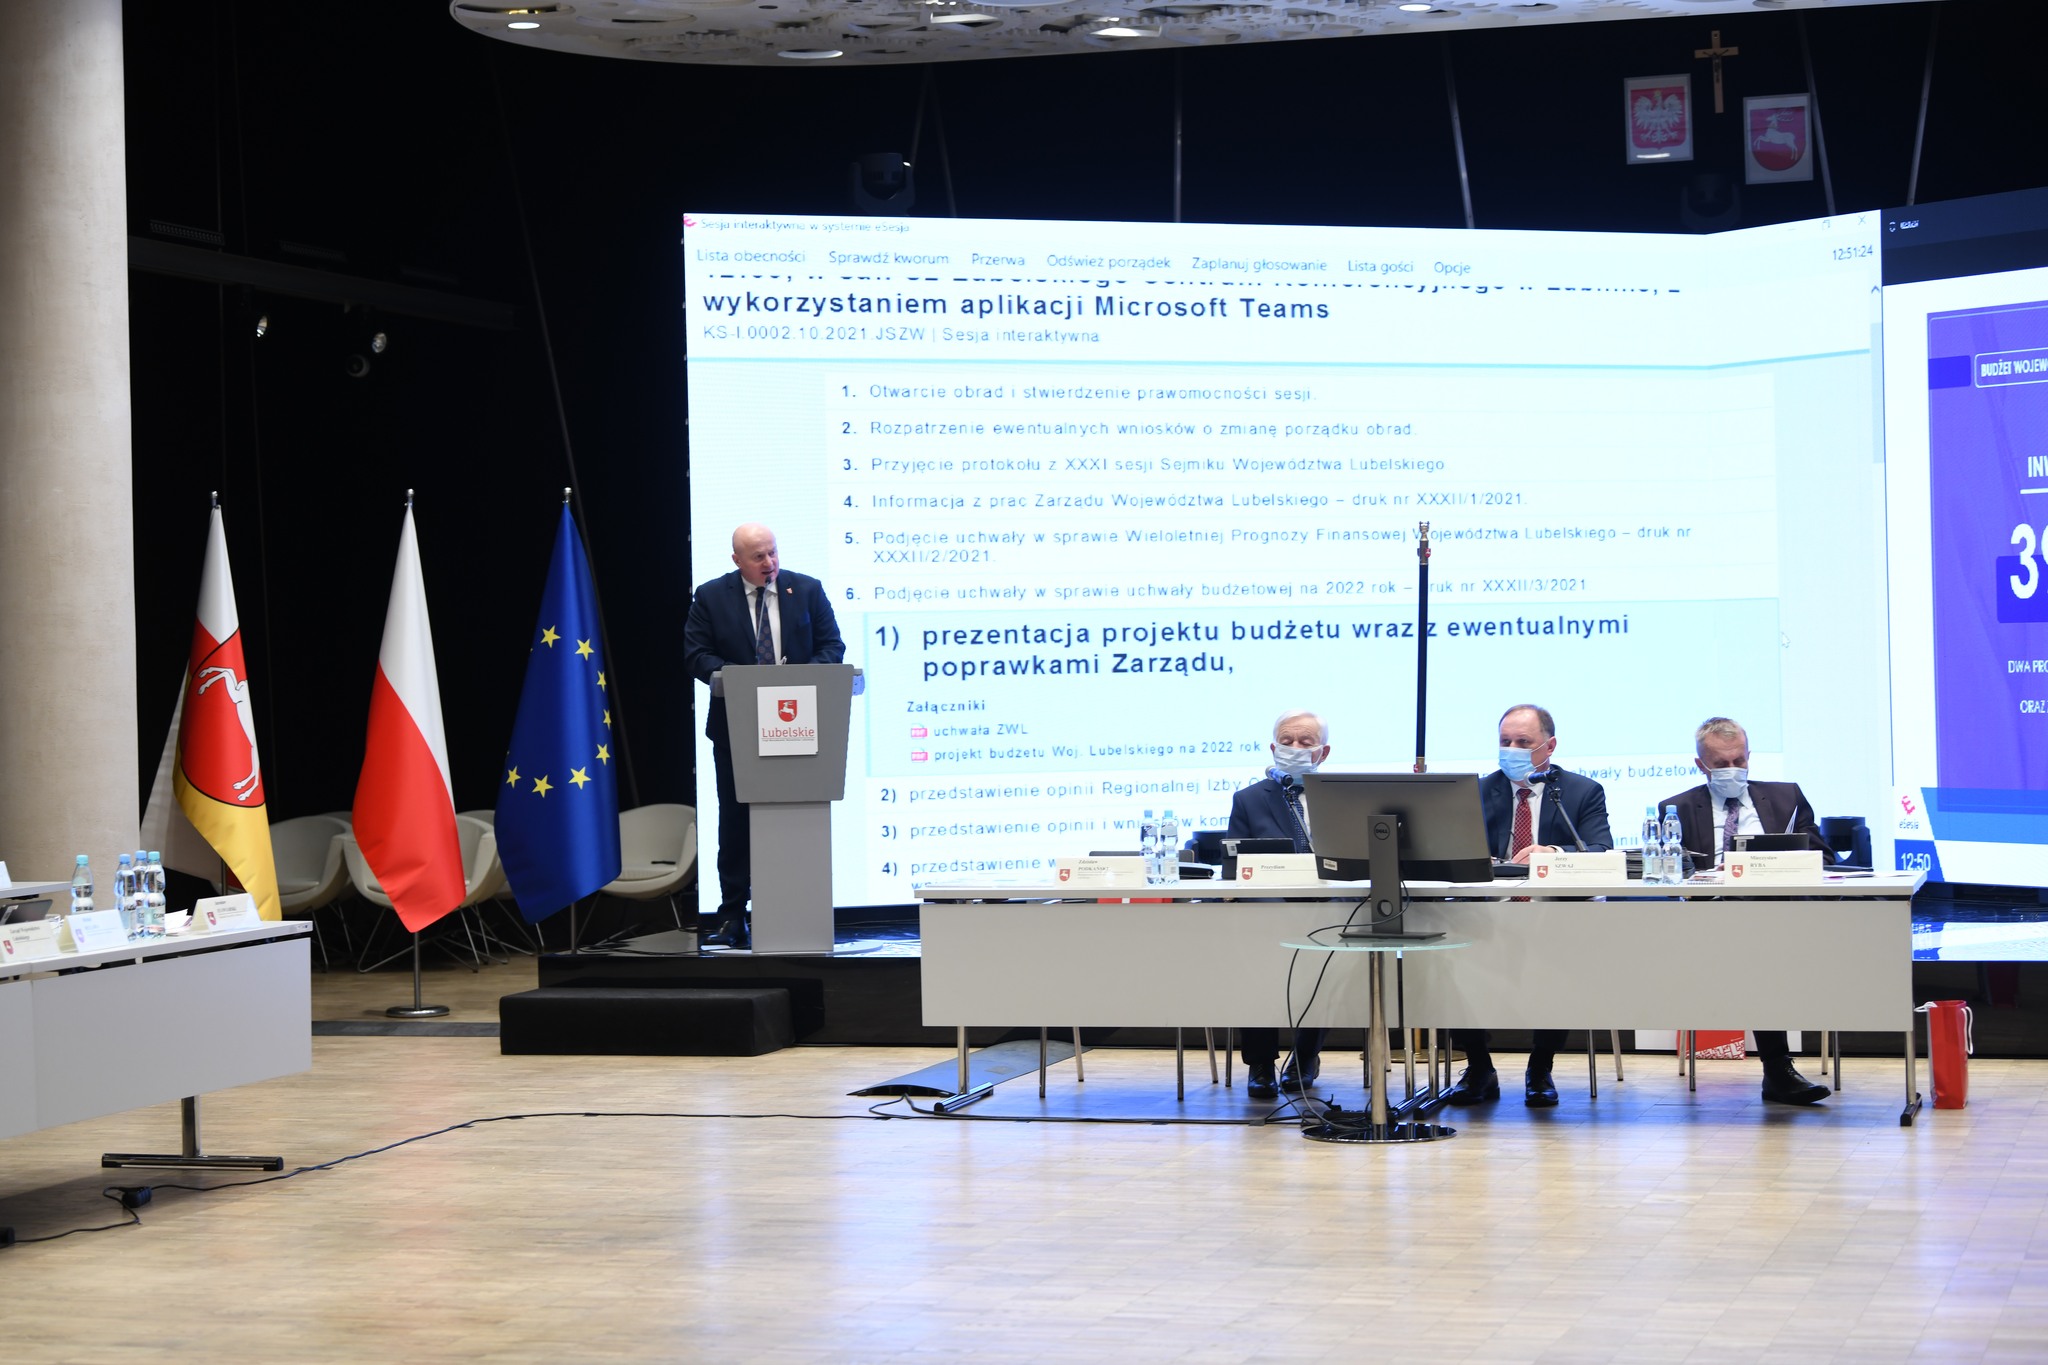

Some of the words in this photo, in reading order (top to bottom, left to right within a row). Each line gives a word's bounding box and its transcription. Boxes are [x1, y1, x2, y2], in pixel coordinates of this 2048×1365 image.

[701, 219, 730, 231] Sesja
[734, 219, 805, 232] interaktywna
[822, 222, 872, 233] systemie
[697, 249, 730, 262] Lista
[734, 250, 805, 263] obecności
[829, 251, 890, 266] Sprawdź
[894, 252, 950, 264] kworum
[972, 253, 1025, 266] Przerwa
[1833, 245, 1874, 260] 12:51:24
[1109, 257, 1171, 270] porządek
[1192, 257, 1249, 272] Zaplanuj
[1253, 259, 1328, 273] głosowanie
[1348, 260, 1377, 272] Lista
[1380, 261, 1413, 275] gości
[1434, 261, 1472, 276] Opcje
[703, 291, 946, 317] wykorzystaniem
[961, 295, 1082, 320] aplikacji
[1096, 296, 1227, 317] Microsoft
[1239, 298, 1329, 318] Teams
[943, 328, 990, 343] Sesja
[997, 329, 1101, 344] interaktywna
[1981, 359, 2012, 377] BUDŻET
[842, 385, 856, 397] 1.
[870, 384, 946, 398] Otwarcie
[954, 385, 1004, 398] obrad
[1023, 386, 1131, 399] stwierdzenie
[1138, 386, 1267, 401] prawomocności
[842, 422, 856, 434] 2.
[871, 422, 984, 436] Rozpatrzenie
[993, 422, 1109, 437] ewentualnych
[1117, 422, 1196, 435] wniosków
[1203, 425, 1213, 435] o
[1220, 425, 1277, 438] zmianę
[1285, 423, 1359, 438] porządku
[843, 458, 857, 470] 3.
[872, 458, 954, 474] Przyjęcie
[962, 458, 1040, 472] protokołu
[1048, 460, 1057, 470] z
[1065, 458, 1107, 470] XXXI
[1115, 460, 1153, 474] sesji
[1161, 458, 1225, 473] Sejmiku
[1233, 458, 1343, 473] Województwa
[1350, 458, 1445, 473] Lubelskiego
[843, 495, 858, 507] 4.
[873, 495, 964, 509] Informacja
[972, 497, 981, 507] z
[990, 497, 1027, 509] prac
[1035, 494, 1104, 508] Zarządu
[1111, 494, 1224, 508] Województwa
[1232, 494, 1328, 508] Lubelskiego
[1353, 494, 1387, 505] druk
[1394, 496, 1410, 505] nr
[845, 532, 859, 544] 5.
[873, 532, 948, 547] Podjęcie
[956, 531, 1025, 546] uchwały
[1034, 533, 1045, 542] w
[1053, 532, 1119, 546] sprawie
[1125, 530, 1224, 544] Wieloletniej
[1232, 529, 1309, 544] Prognozy
[1317, 528, 1406, 543] Finansowej
[1525, 527, 1616, 541] Lubelskiego
[1637, 527, 1670, 538] druk
[1677, 528, 1691, 537] nr
[846, 588, 860, 600] 6.
[875, 587, 950, 602] Podjęcie
[957, 585, 1026, 601] uchwały
[1035, 588, 1046, 597] w
[1055, 587, 1120, 600] sprawie
[1127, 584, 1193, 599] uchwały
[1202, 583, 1292, 597] budżetowej
[1300, 584, 1318, 594] na
[1326, 581, 1364, 594] 2022
[1372, 581, 1396, 593] rok
[1430, 581, 1452, 592] ruk
[1461, 583, 1475, 592] nr
[876, 626, 899, 651] 1)
[923, 623, 1090, 650] prezentacja
[1103, 622, 1219, 647] projektu
[1232, 620, 1340, 640] budżetu
[1352, 623, 1414, 638] wraz
[1426, 622, 1438, 638] z
[1448, 614, 1628, 639] ewentualnymi
[924, 654, 1098, 682] poprawkami
[1112, 652, 1233, 676] Zarządu,
[2008, 660, 2031, 673] DWA
[907, 700, 985, 714] Załączniki
[762, 727, 815, 738] Lubelskie
[934, 725, 990, 736] uchwała
[997, 723, 1028, 735] ZWL
[935, 748, 982, 762] projekt
[1090, 745, 1174, 757] Lubelskiego
[1180, 745, 1196, 753] na
[1202, 741, 1232, 753] 2022
[1240, 741, 1261, 752] rok
[881, 788, 896, 803] 2)
[910, 786, 1040, 803] przedstawienie
[1047, 785, 1094, 798] opinii
[1102, 780, 1200, 797] Regionalnej
[1208, 778, 1240, 792] Izby
[882, 825, 896, 840] 3)
[911, 823, 1041, 839] przedstawienie
[1047, 821, 1095, 834] opinii
[882, 862, 897, 876] 4)
[911, 859, 1041, 876] przedstawienie
[1901, 852, 1932, 872] 12:50
